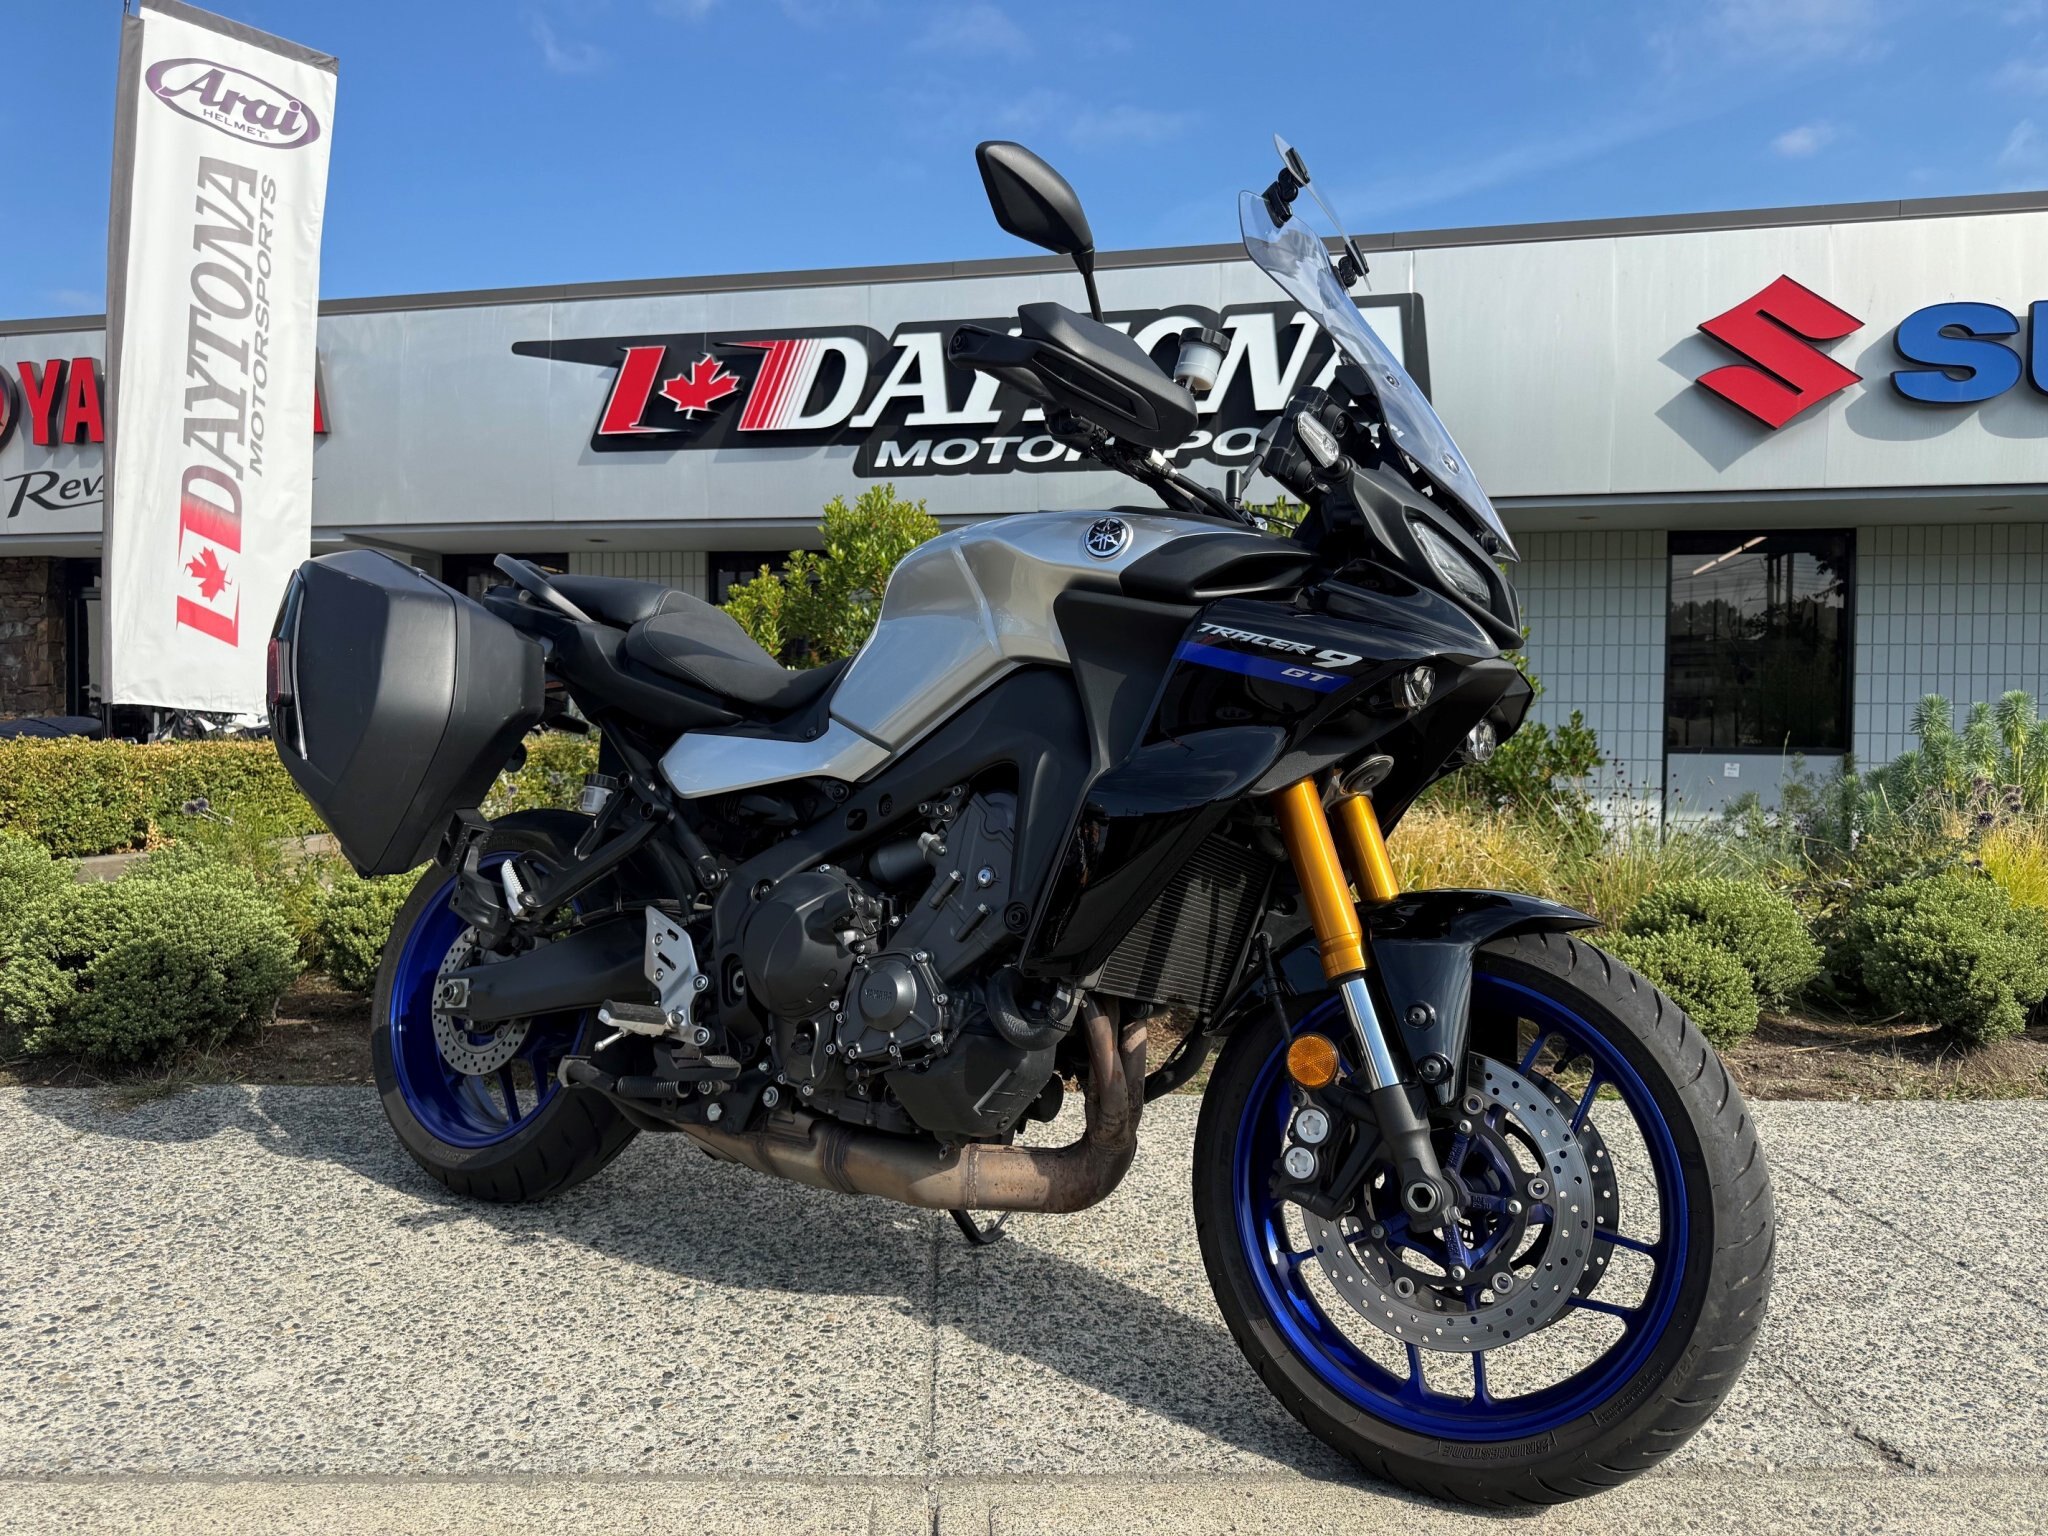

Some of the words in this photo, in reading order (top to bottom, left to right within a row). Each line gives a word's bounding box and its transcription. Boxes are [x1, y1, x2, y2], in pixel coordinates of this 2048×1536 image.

[156, 68, 302, 136] Arai
[203, 108, 267, 140] HELMET
[250, 175, 276, 477] MOTORSPORTS
[178, 156, 258, 556] DAYTONA
[4, 470, 104, 518] Rev
[1197, 622, 1316, 655] TRACER
[1311, 649, 1363, 669] 9
[1280, 667, 1335, 682] GT
